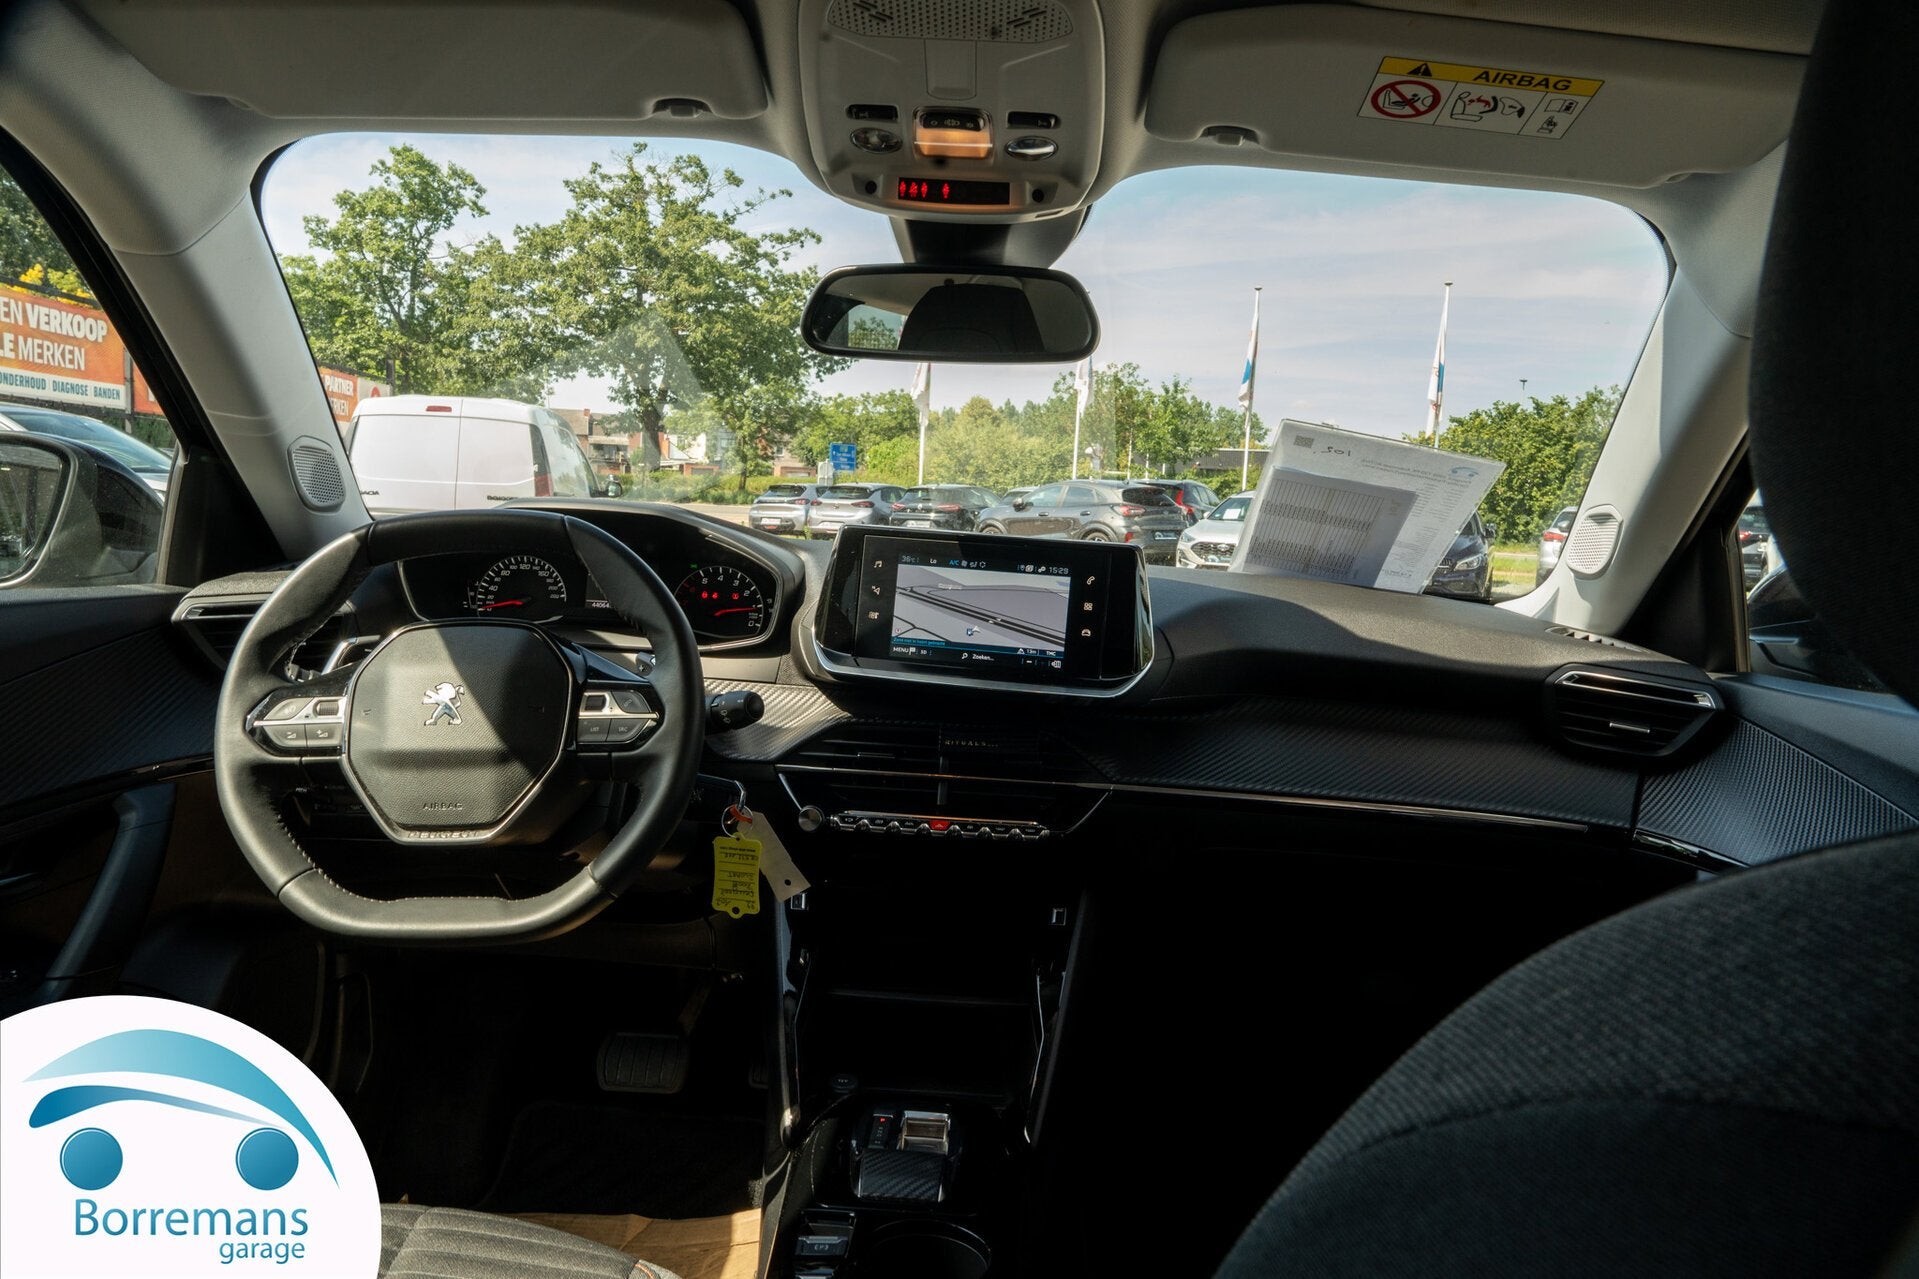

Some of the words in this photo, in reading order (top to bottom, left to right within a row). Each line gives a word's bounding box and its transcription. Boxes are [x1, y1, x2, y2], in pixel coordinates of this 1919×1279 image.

[1472, 70, 1573, 91] AIRBAG
[25, 302, 108, 343] VERKOOP
[0, 332, 15, 359] E
[18, 335, 86, 371] MERKEN
[52, 380, 89, 397] DIAGNOSE
[93, 386, 121, 401] BANDEN
[422, 802, 463, 811] AIRBAG
[408, 831, 478, 839] PEUGEOT
